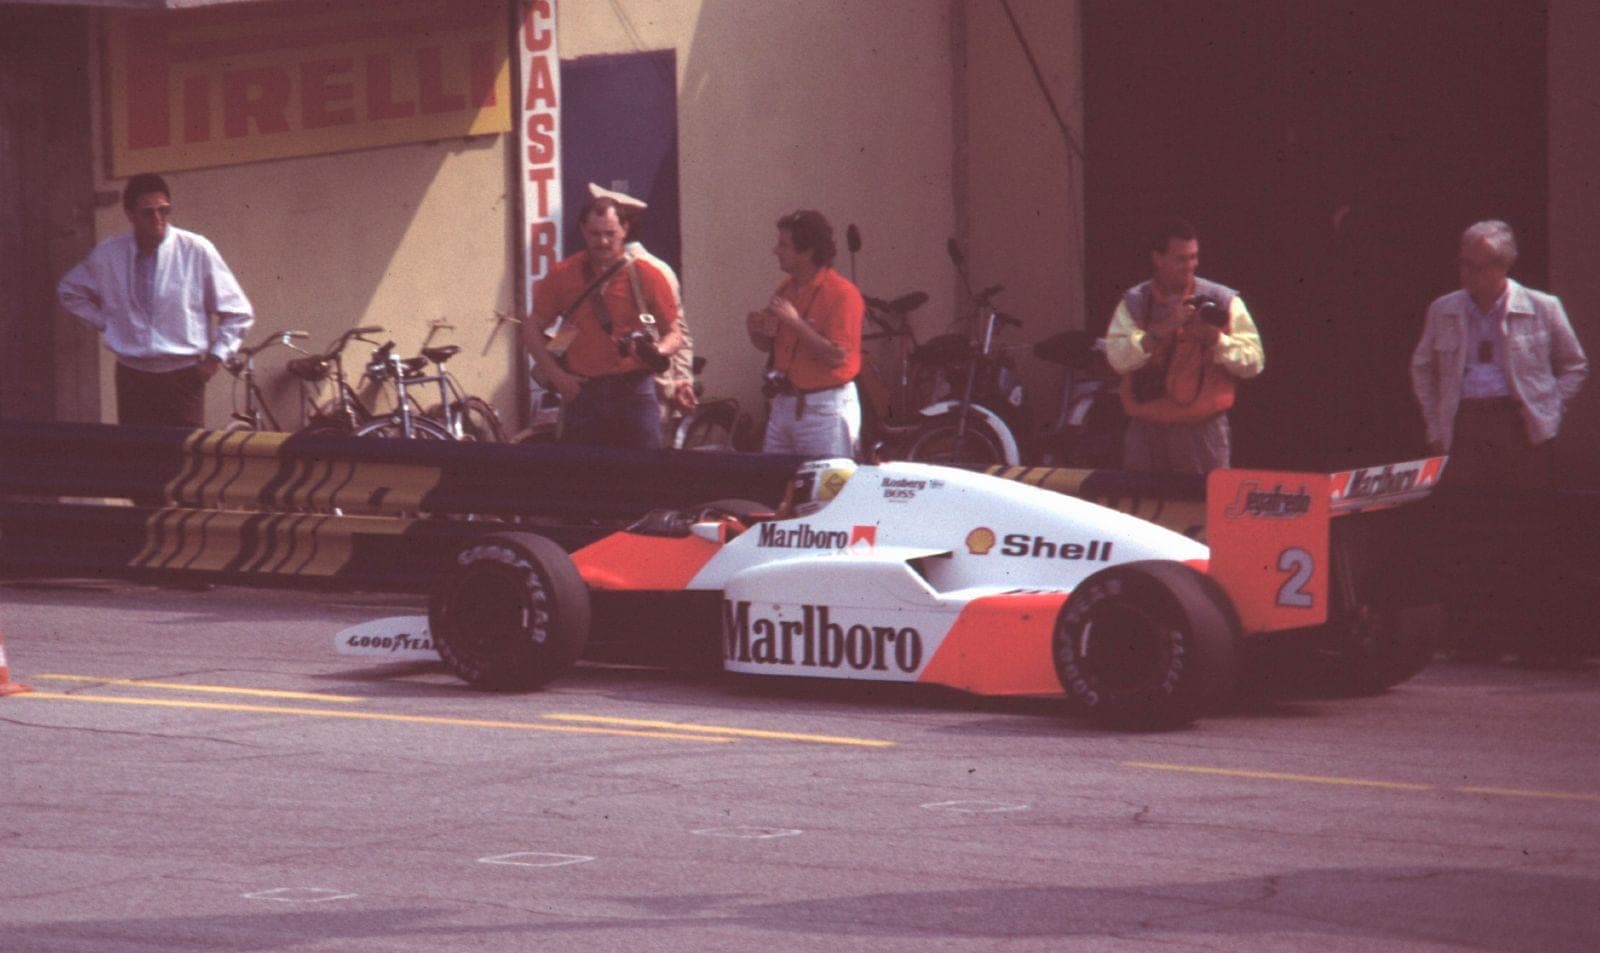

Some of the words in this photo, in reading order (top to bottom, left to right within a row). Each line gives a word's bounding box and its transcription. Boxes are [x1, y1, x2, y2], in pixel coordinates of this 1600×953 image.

[128, 14, 497, 150] PIRELLI
[524, 0, 557, 278] CASTR
[882, 488, 916, 499] BOSS
[757, 522, 848, 550] Marlboro
[1001, 533, 1113, 562] Shell
[1275, 547, 1314, 608] 2
[724, 599, 923, 674] Marlboro
